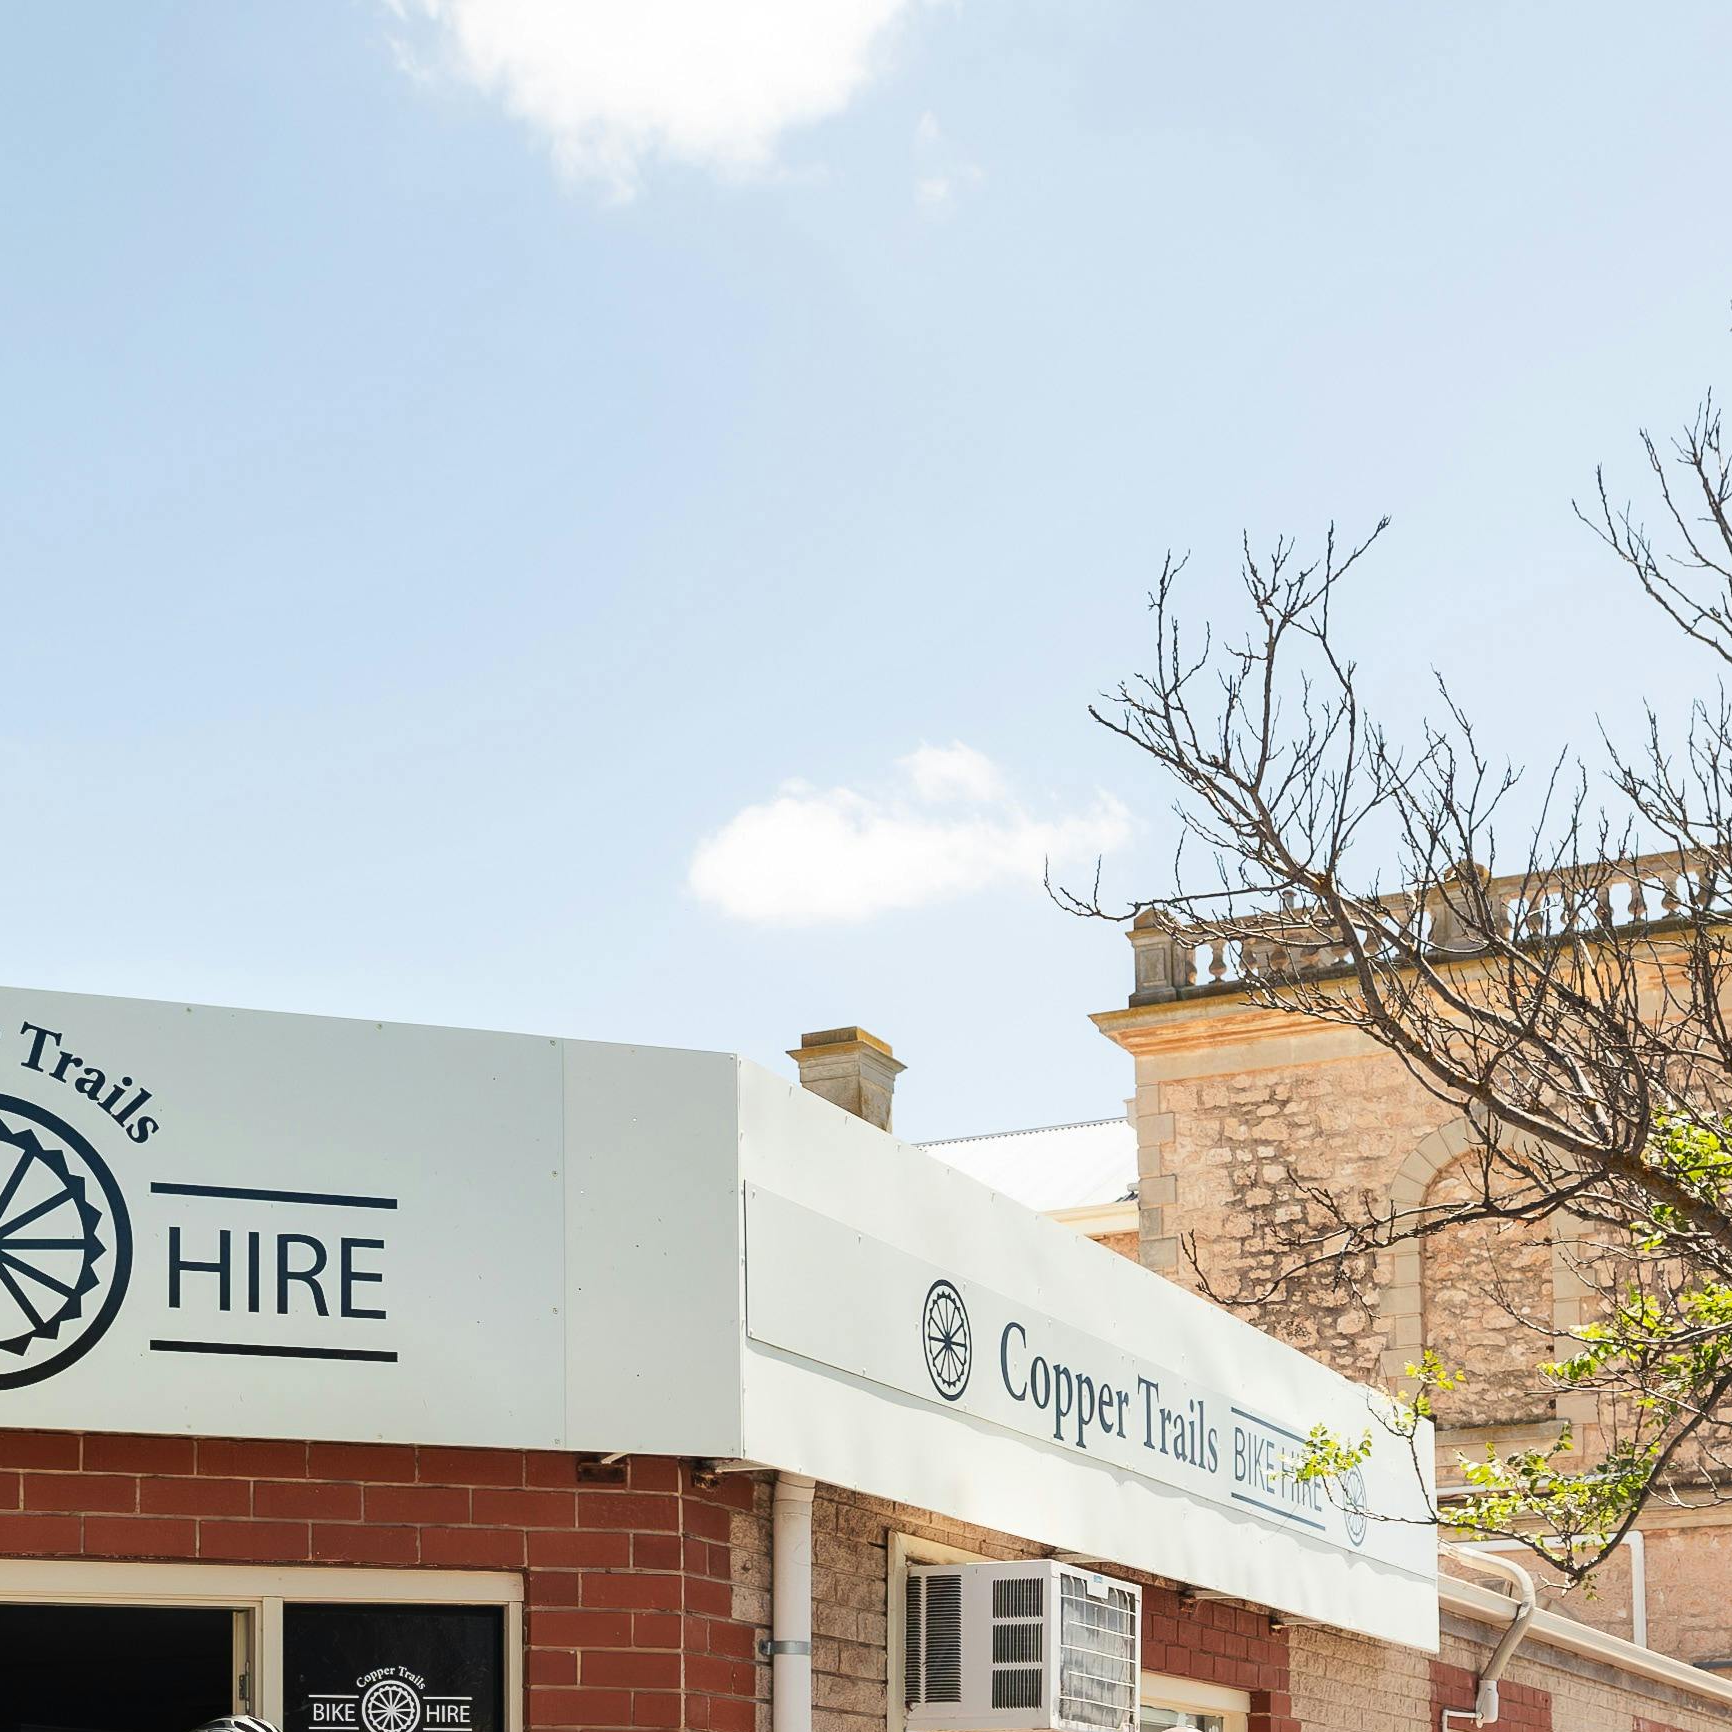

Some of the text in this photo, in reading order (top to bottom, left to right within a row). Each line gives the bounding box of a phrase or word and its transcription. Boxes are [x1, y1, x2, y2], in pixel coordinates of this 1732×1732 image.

[19, 1020, 162, 1146] Trails
[169, 1227, 387, 1320] HIRE
[1000, 1322, 1129, 1449] Copper
[1136, 1374, 1219, 1476] Trails
[1234, 1426, 1275, 1495] BIKE
[312, 1703, 471, 1723] BIKE HIRE
[356, 1665, 427, 1691] Copper Trails
